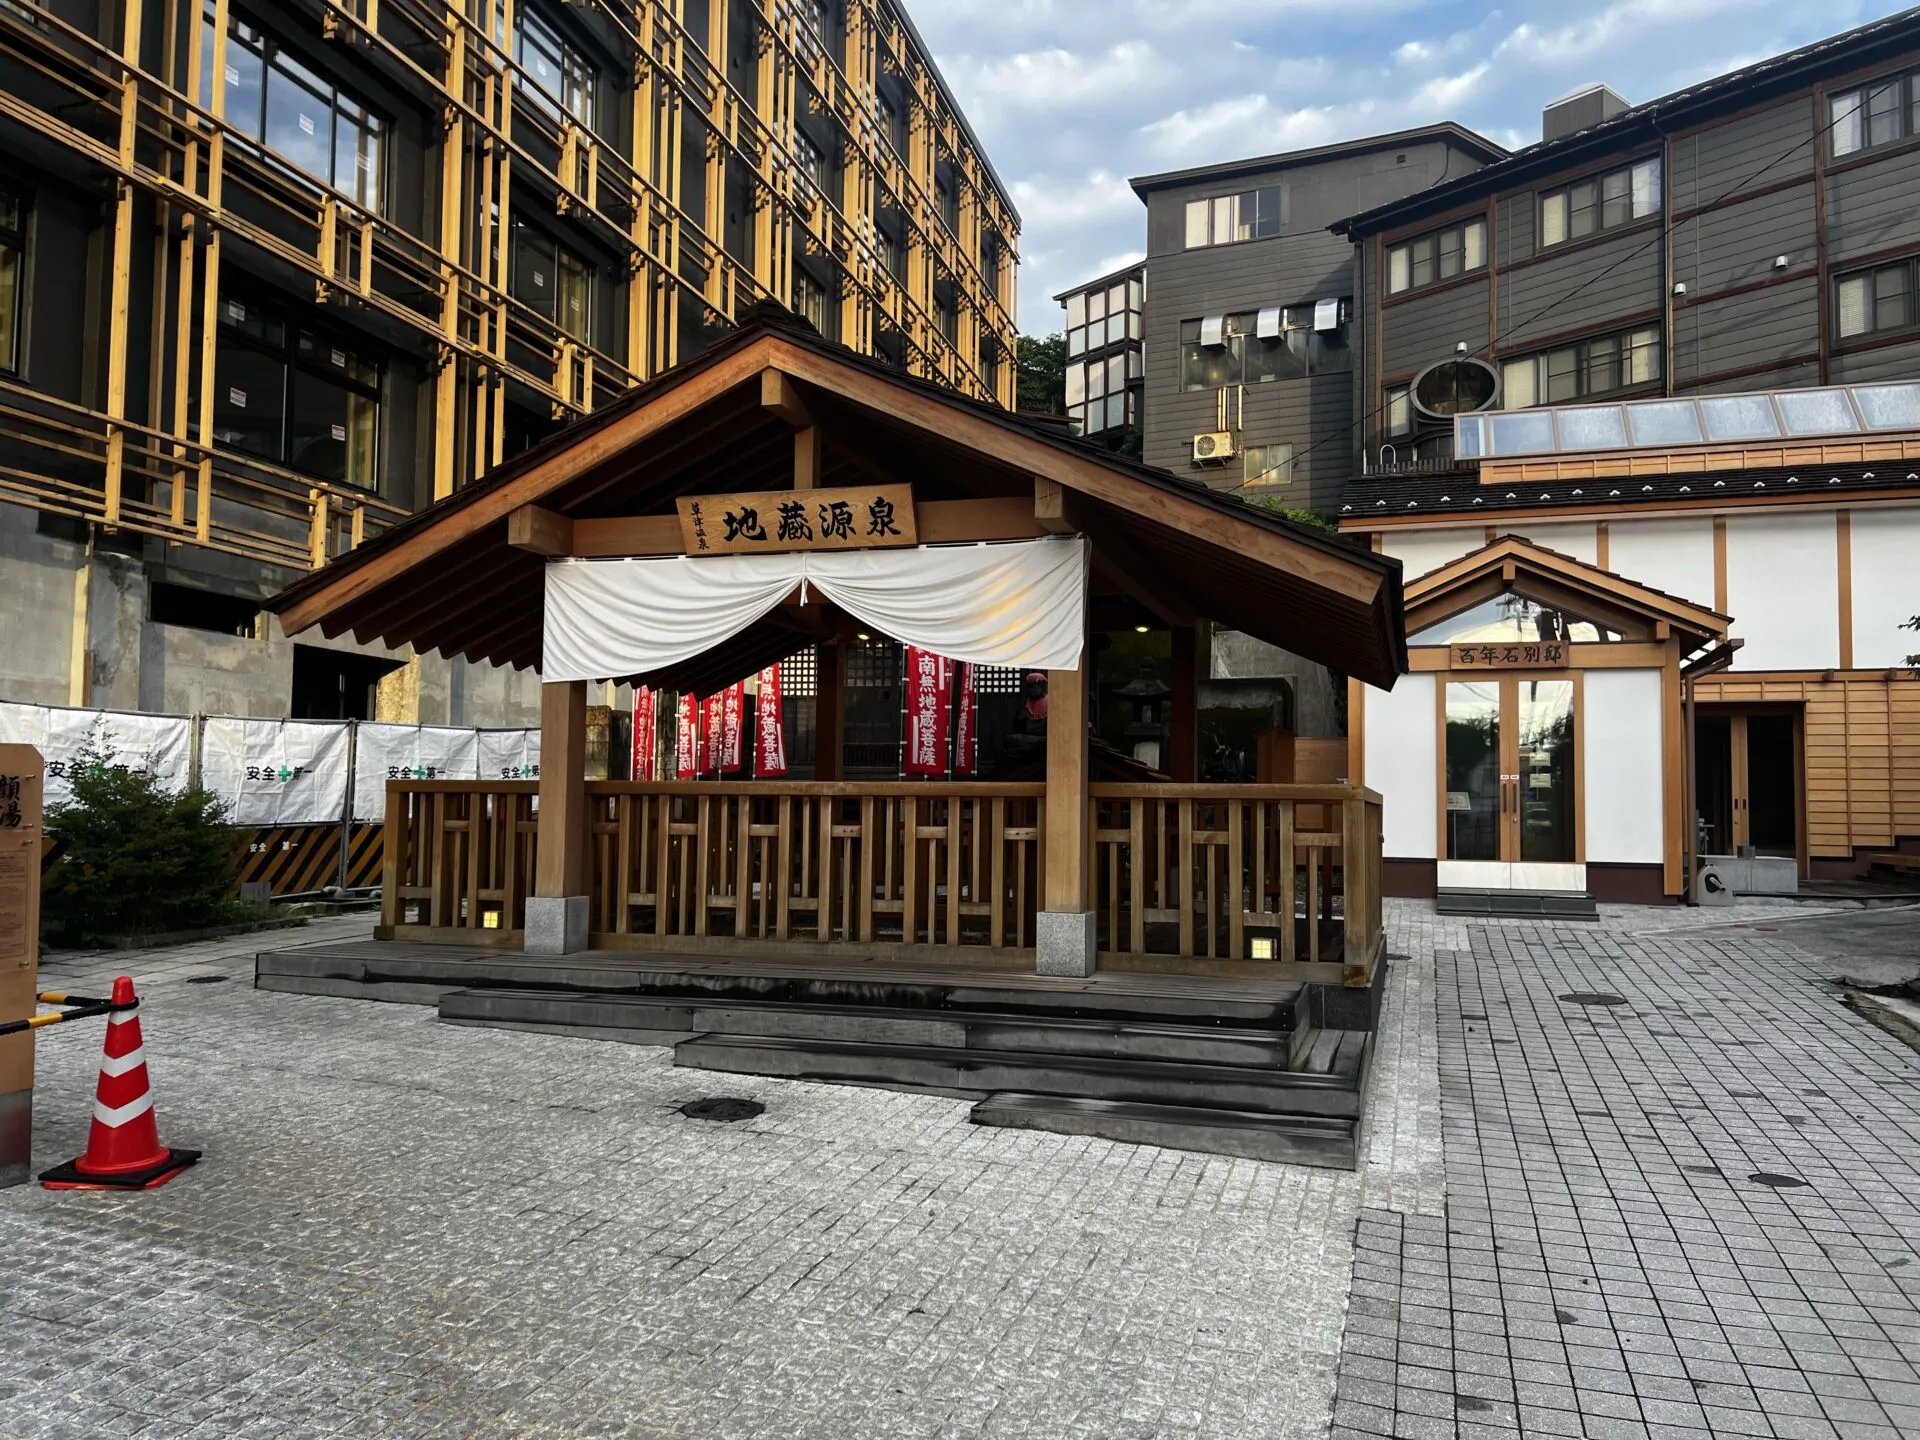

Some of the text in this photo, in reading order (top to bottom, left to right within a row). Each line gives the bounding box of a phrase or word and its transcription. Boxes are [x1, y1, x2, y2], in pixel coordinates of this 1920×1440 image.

[1458, 645, 1562, 665] 百年石別邸
[246, 766, 276, 781] 安全
[388, 766, 412, 779] 安全
[501, 767, 520, 779] 安全
